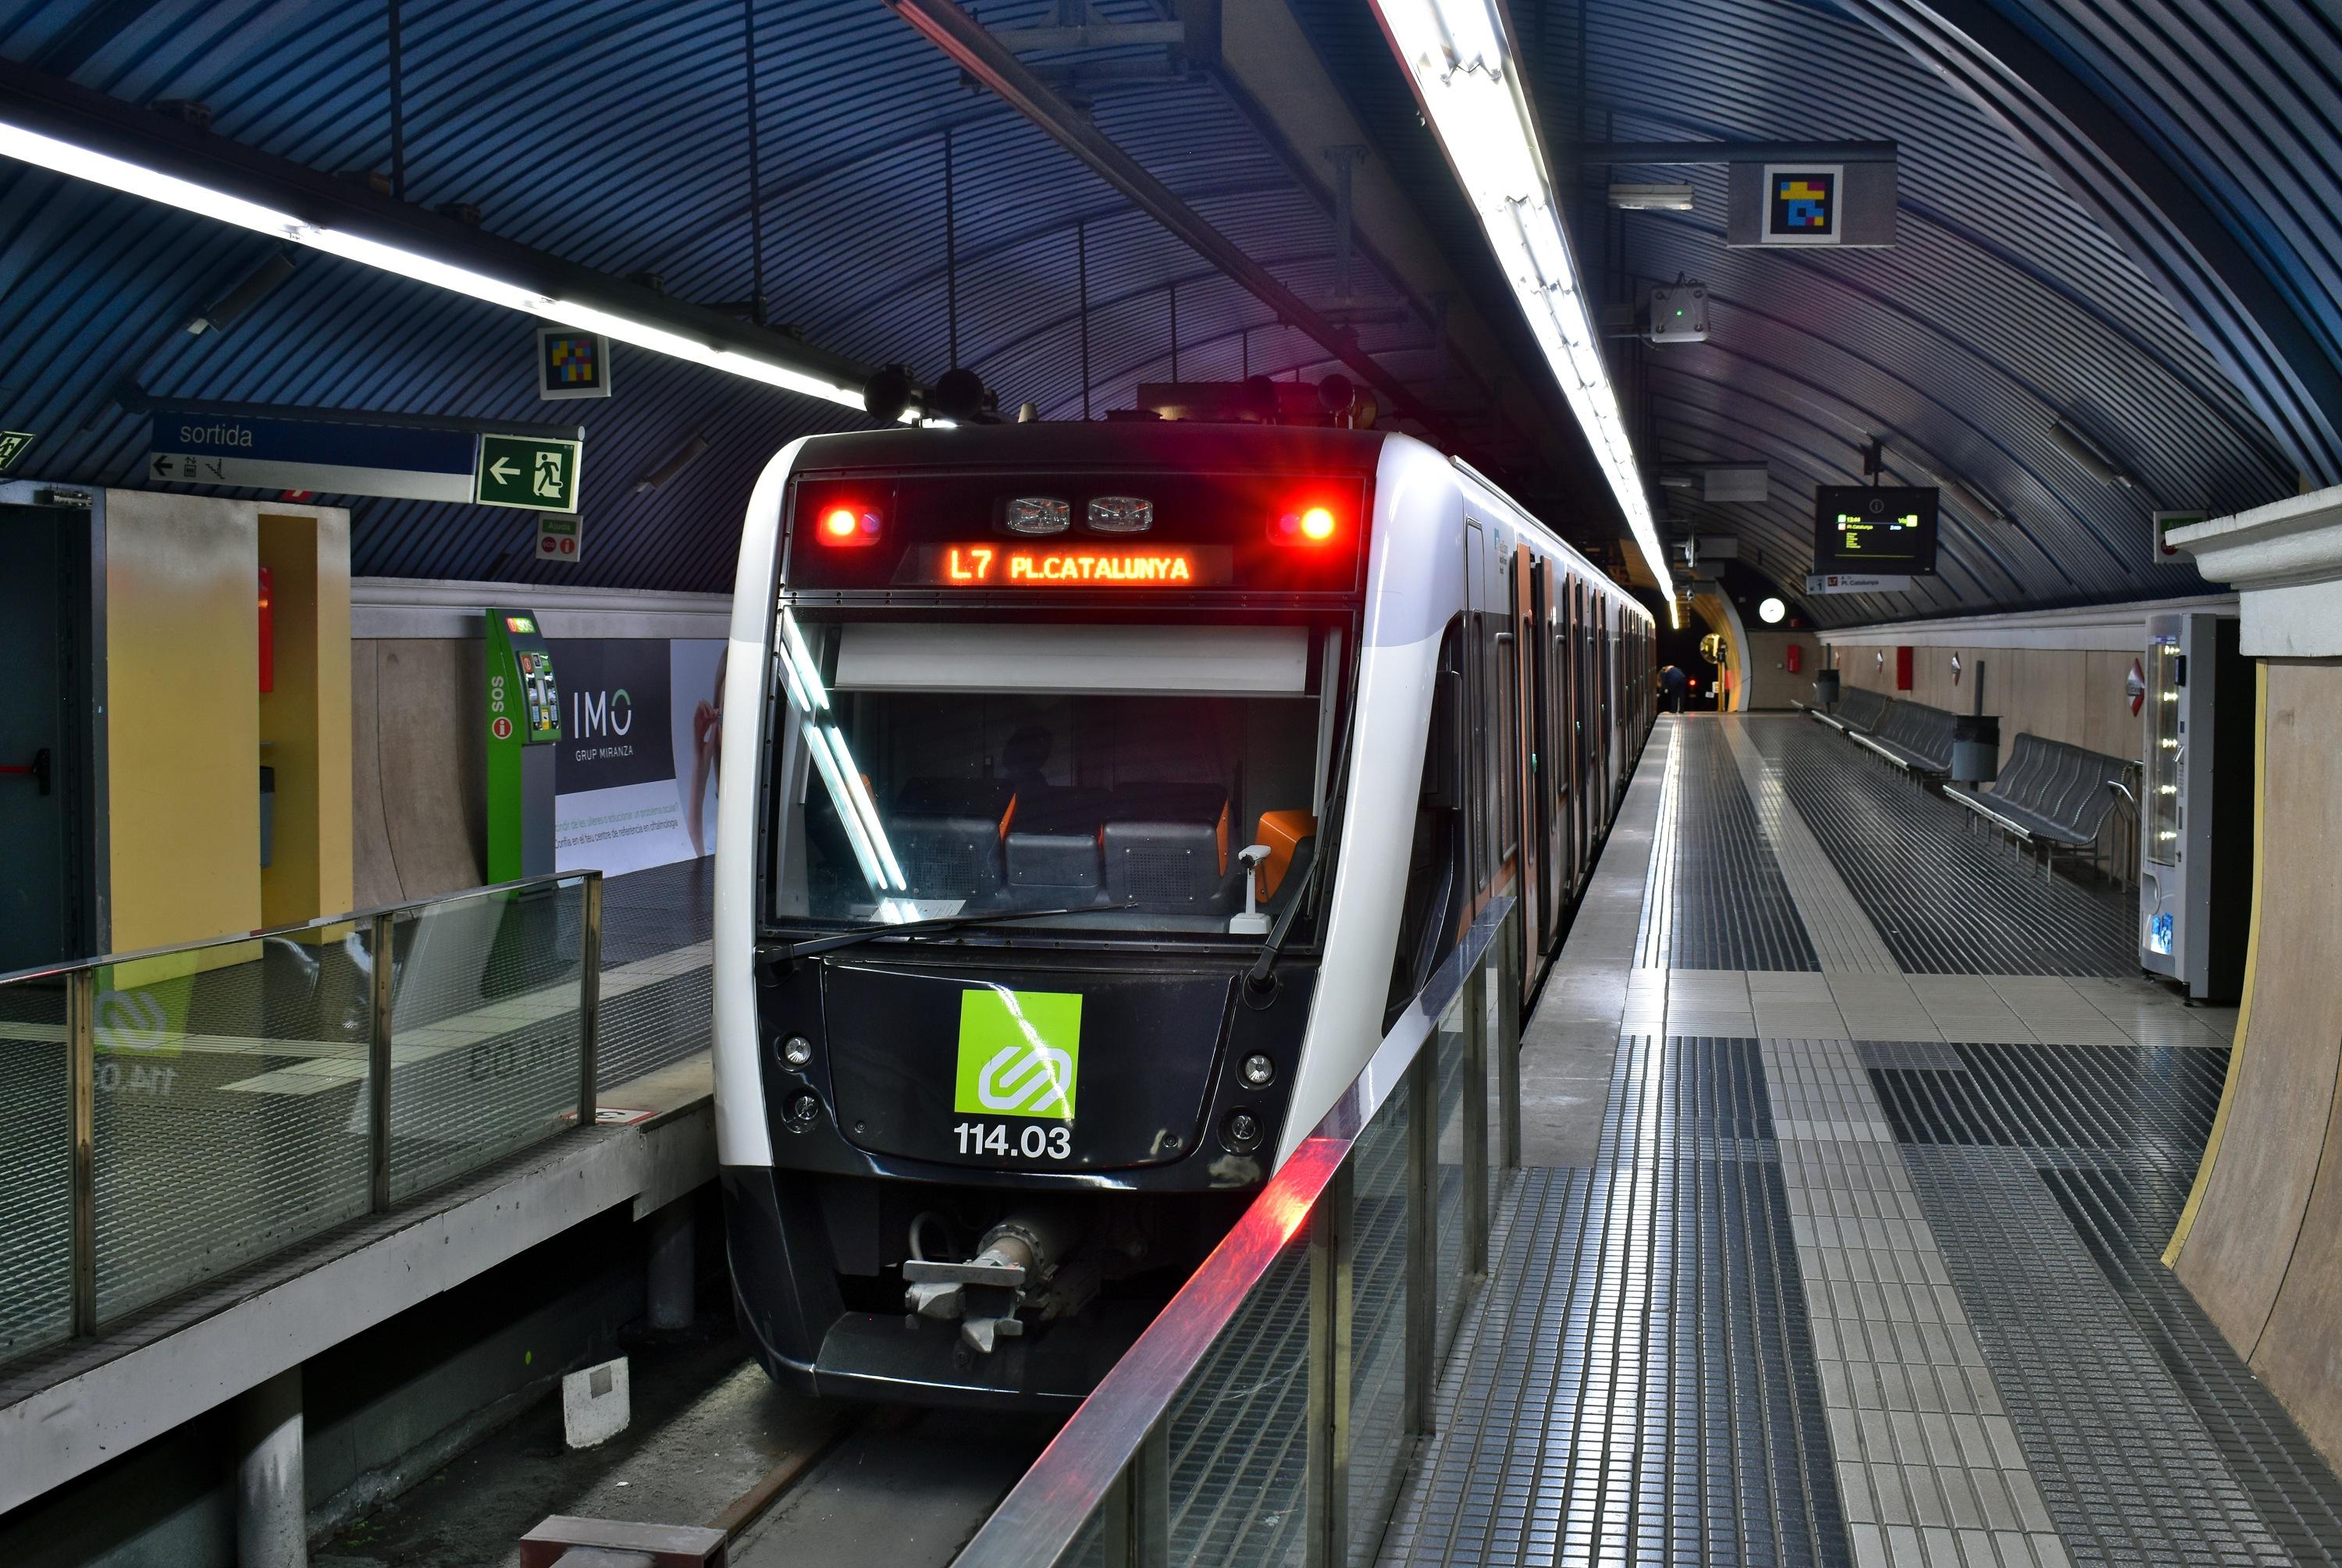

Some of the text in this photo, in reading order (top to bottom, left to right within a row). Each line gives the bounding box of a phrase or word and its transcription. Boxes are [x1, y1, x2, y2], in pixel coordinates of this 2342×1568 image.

[180, 424, 252, 446] sortida
[548, 522, 571, 532] Ajuda
[950, 549, 1190, 579] L7 PL.CATALUNYA
[516, 618, 534, 631] SOS
[491, 676, 504, 713] SOS
[574, 688, 632, 738] IMO
[575, 745, 634, 762] GRUP MIRANZA
[572, 837, 579, 846] en
[579, 834, 585, 844] el
[585, 834, 594, 843] teu
[595, 831, 611, 841] centre
[611, 828, 618, 837] de
[953, 1122, 1071, 1160] 114.03
